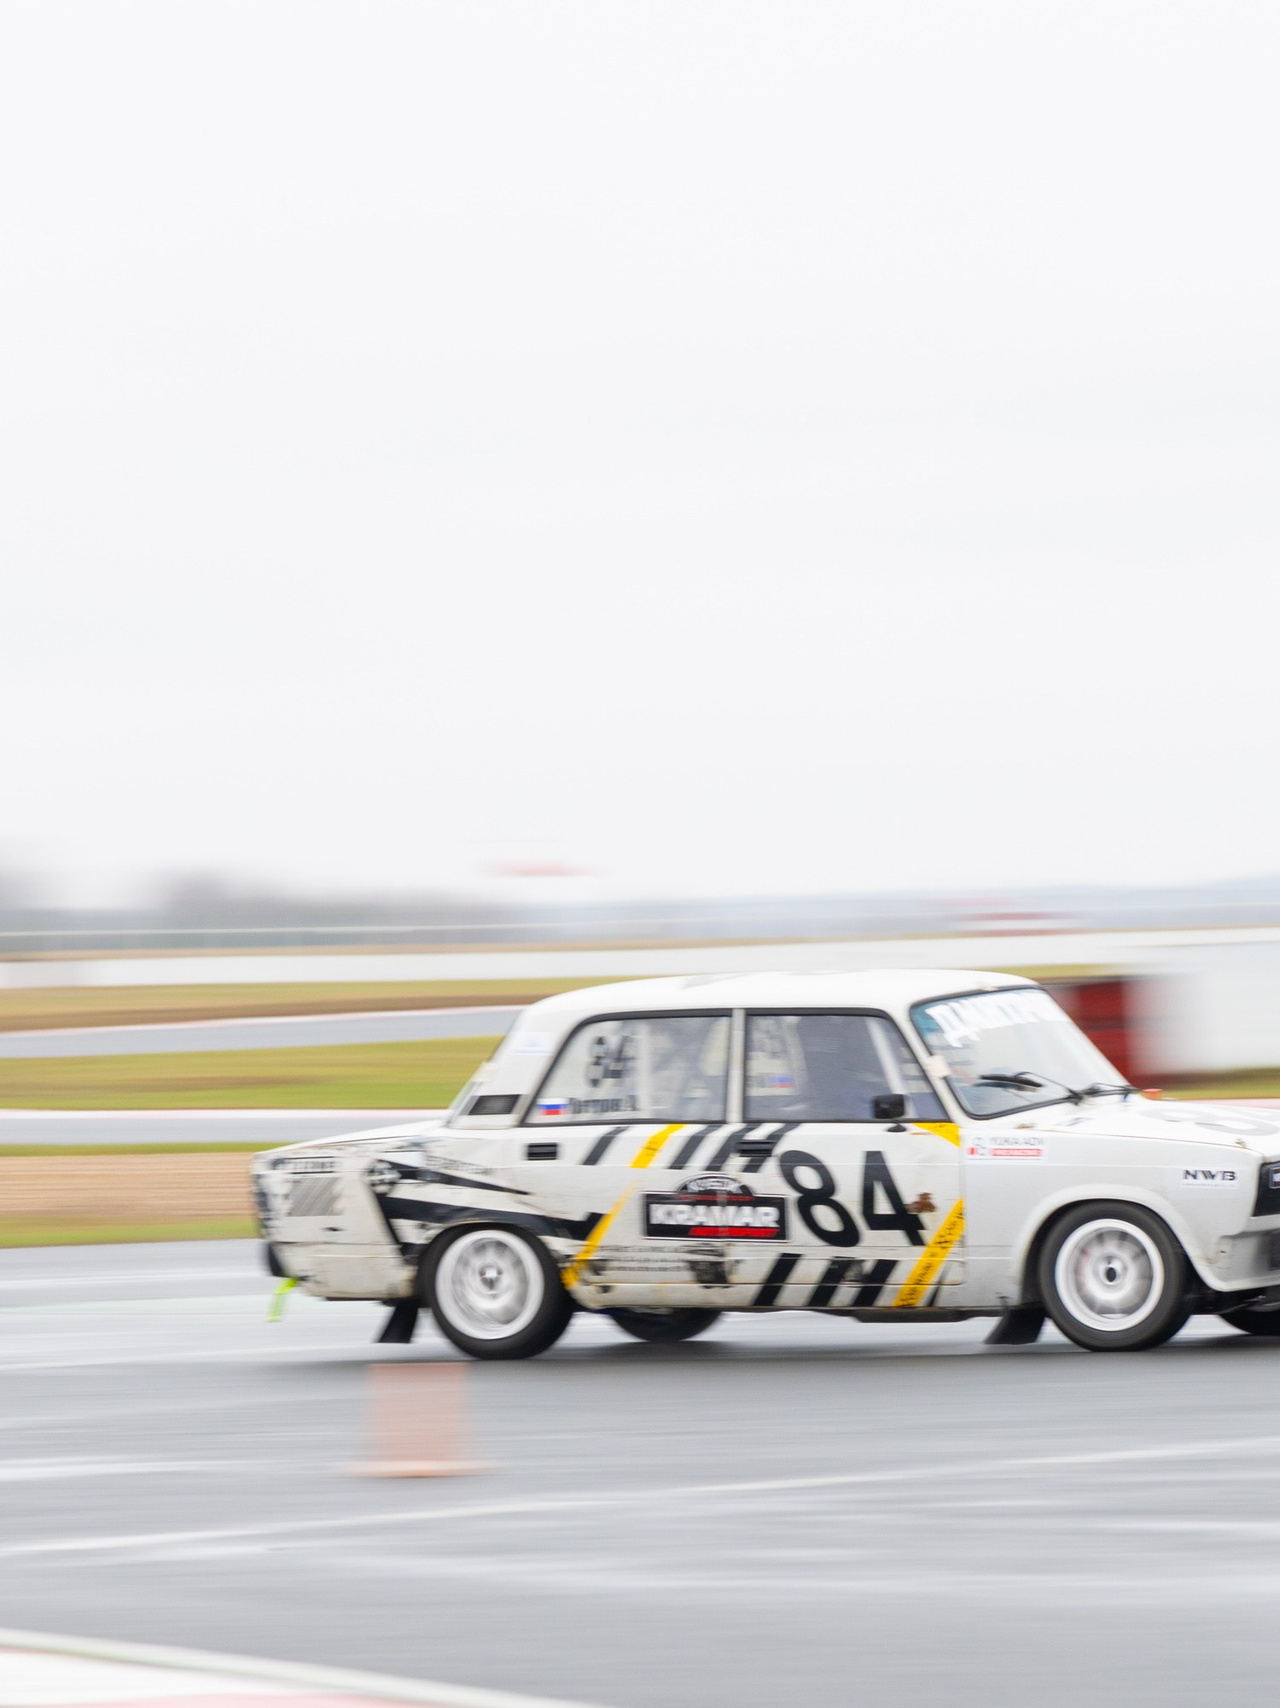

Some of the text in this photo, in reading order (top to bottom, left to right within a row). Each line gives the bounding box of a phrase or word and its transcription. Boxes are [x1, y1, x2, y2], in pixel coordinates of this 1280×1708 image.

[1183, 1168, 1237, 1181] NWB
[779, 1149, 927, 1248] 84
[649, 1203, 781, 1228] KRAMAR
